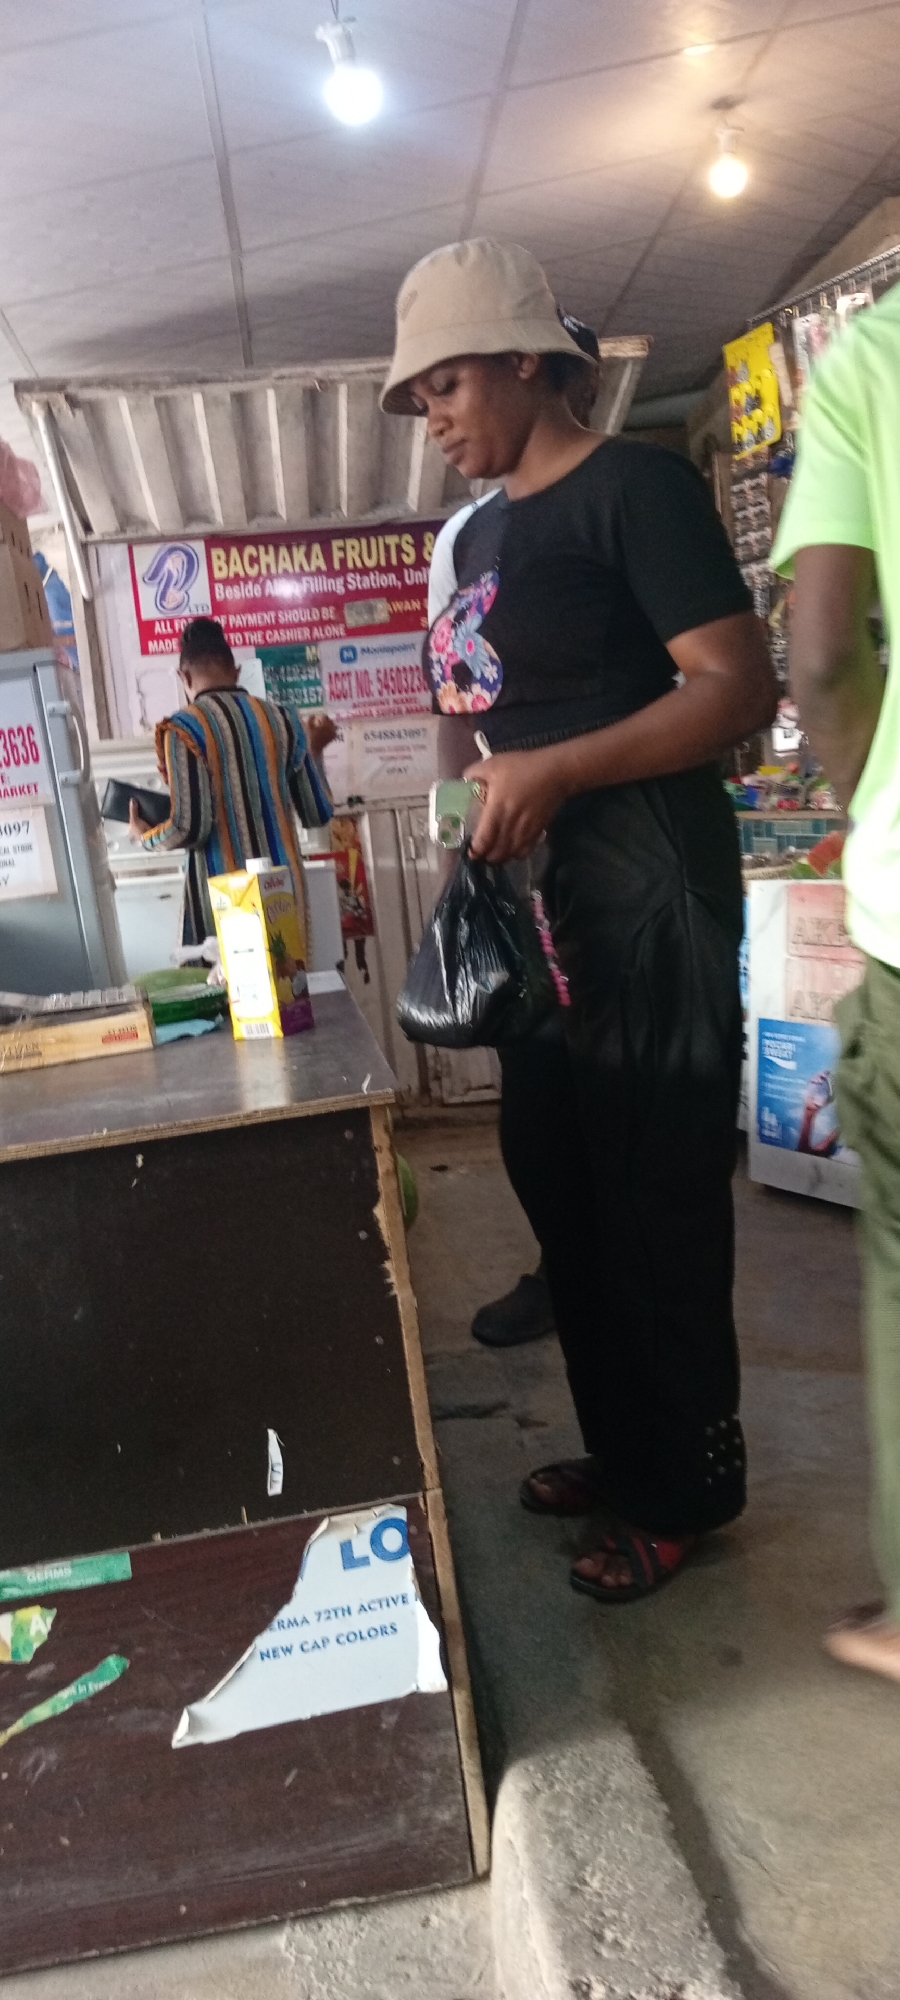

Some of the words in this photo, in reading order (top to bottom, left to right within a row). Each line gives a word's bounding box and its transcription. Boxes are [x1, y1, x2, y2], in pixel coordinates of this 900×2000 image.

[210, 542, 327, 580] BACHAKA
[330, 533, 416, 571] FRUITS
[214, 580, 262, 601] Beside
[346, 569, 402, 591] Station,
[403, 566, 431, 586] Uni
[154, 619, 173, 635] ALL
[228, 610, 277, 629] PAYMENT
[277, 606, 321, 625] SHOULD
[320, 605, 336, 621] BE
[147, 637, 180, 655] MADE
[228, 632, 244, 647] TO
[243, 630, 265, 646] THE
[265, 626, 311, 644] CASHIER
[311, 622, 346, 641] ALONE
[328, 672, 353, 701] ACCT
[0, 725, 40, 768] 3636
[0, 782, 39, 798] ARKET
[315, 1606, 352, 1622] 72TH
[358, 1593, 410, 1614] ACTIVE
[259, 1645, 293, 1662] NEW
[300, 1638, 331, 1653] CAP
[336, 1622, 399, 1645] COLORS
